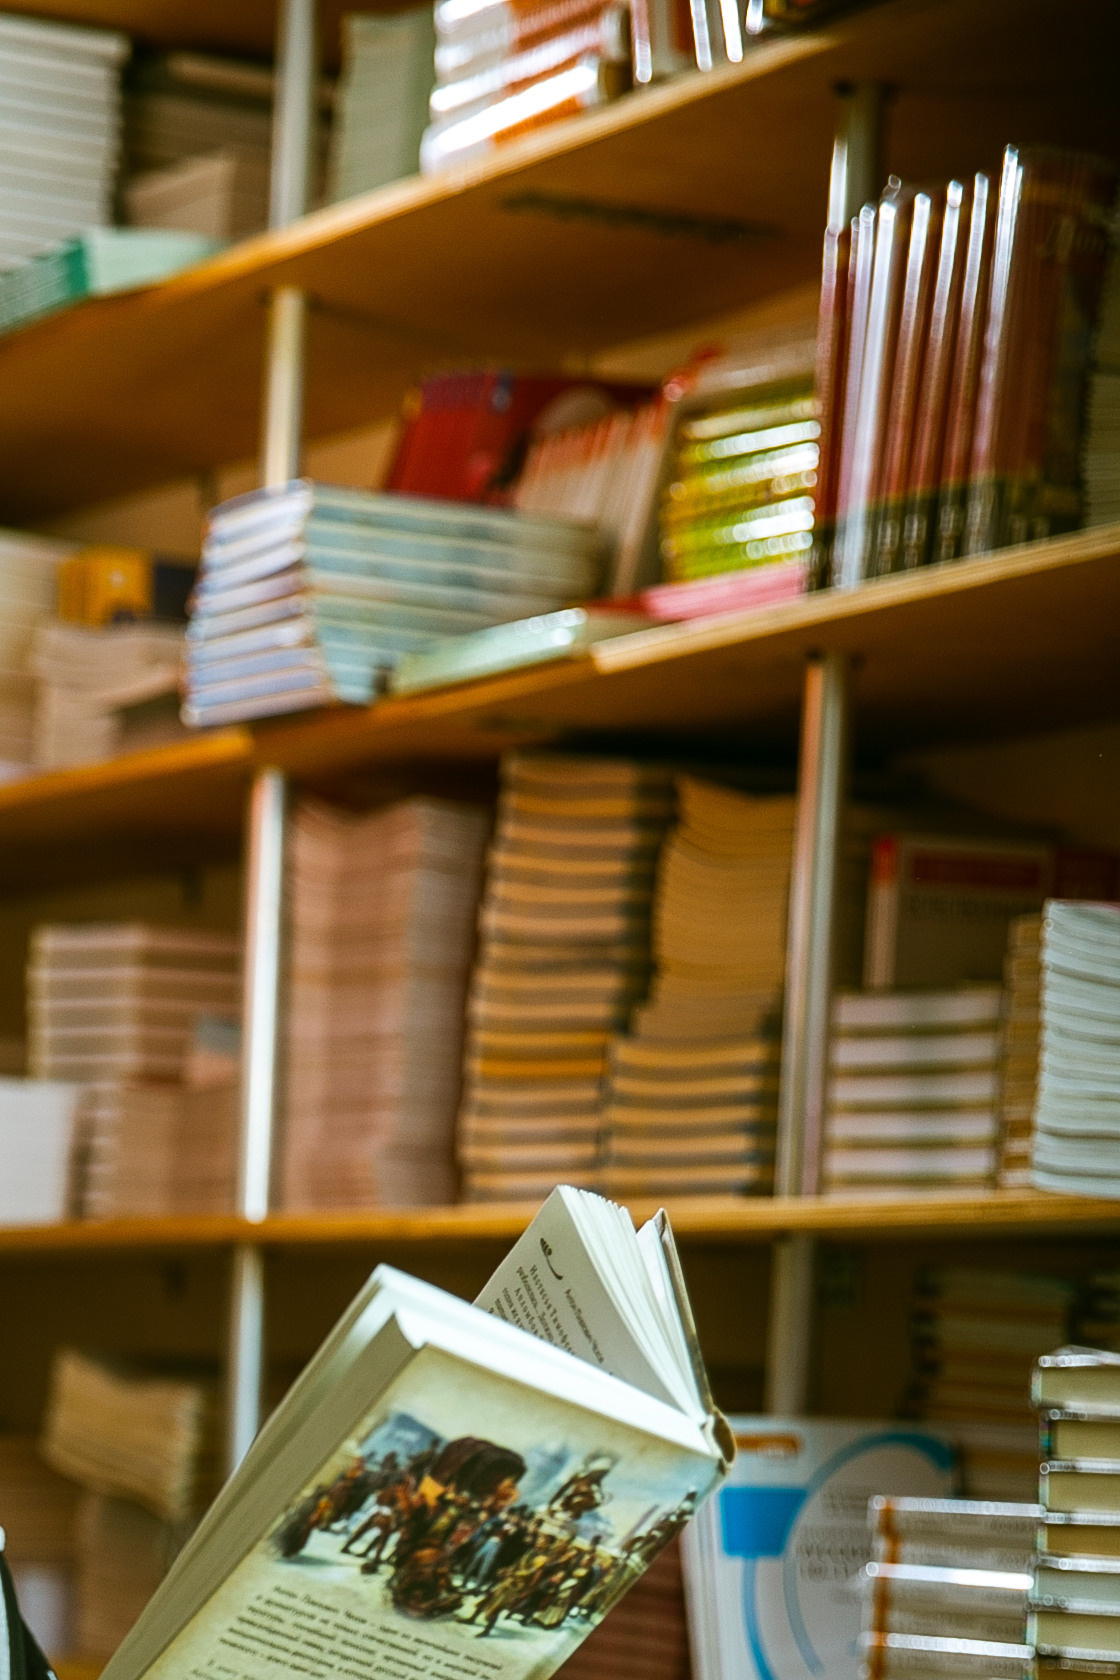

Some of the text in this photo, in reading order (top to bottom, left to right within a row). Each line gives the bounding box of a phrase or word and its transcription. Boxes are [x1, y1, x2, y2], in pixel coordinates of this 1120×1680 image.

[301, 1596, 341, 1613] Павлович
[342, 1610, 368, 1623] Чехов
[374, 1664, 408, 1680] русской
